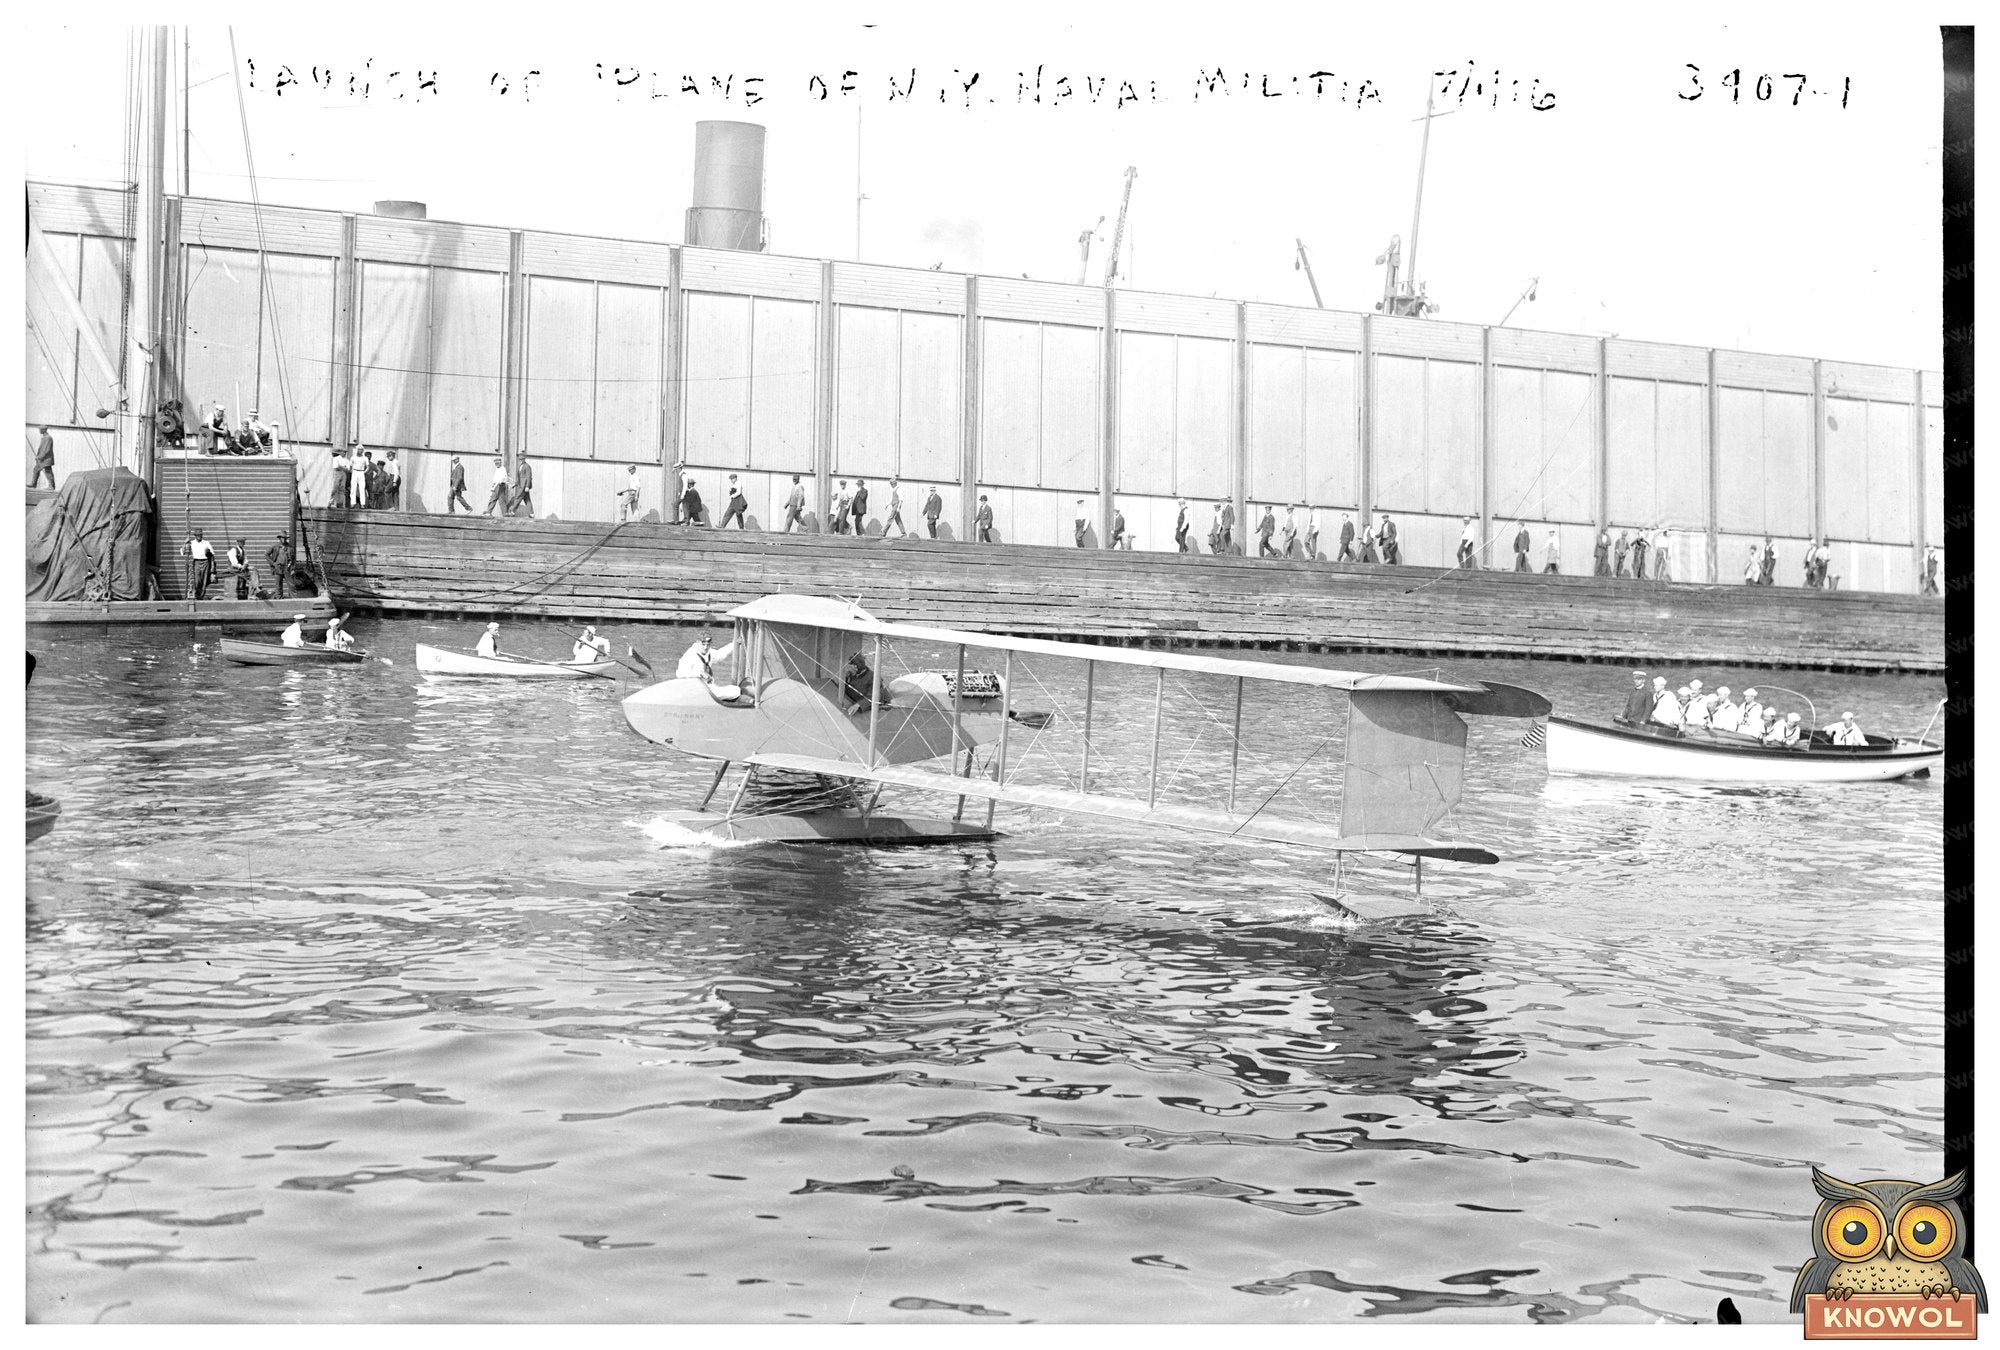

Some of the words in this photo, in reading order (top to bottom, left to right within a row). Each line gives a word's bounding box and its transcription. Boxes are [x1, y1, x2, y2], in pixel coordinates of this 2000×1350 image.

[247, 57, 438, 103] LAUNCH
[490, 70, 541, 102] OF
[809, 70, 858, 101] OF
[1018, 64, 1158, 109] NAVAL
[1195, 67, 1382, 109] MILITIA
[1678, 64, 1851, 109] 3907-1
